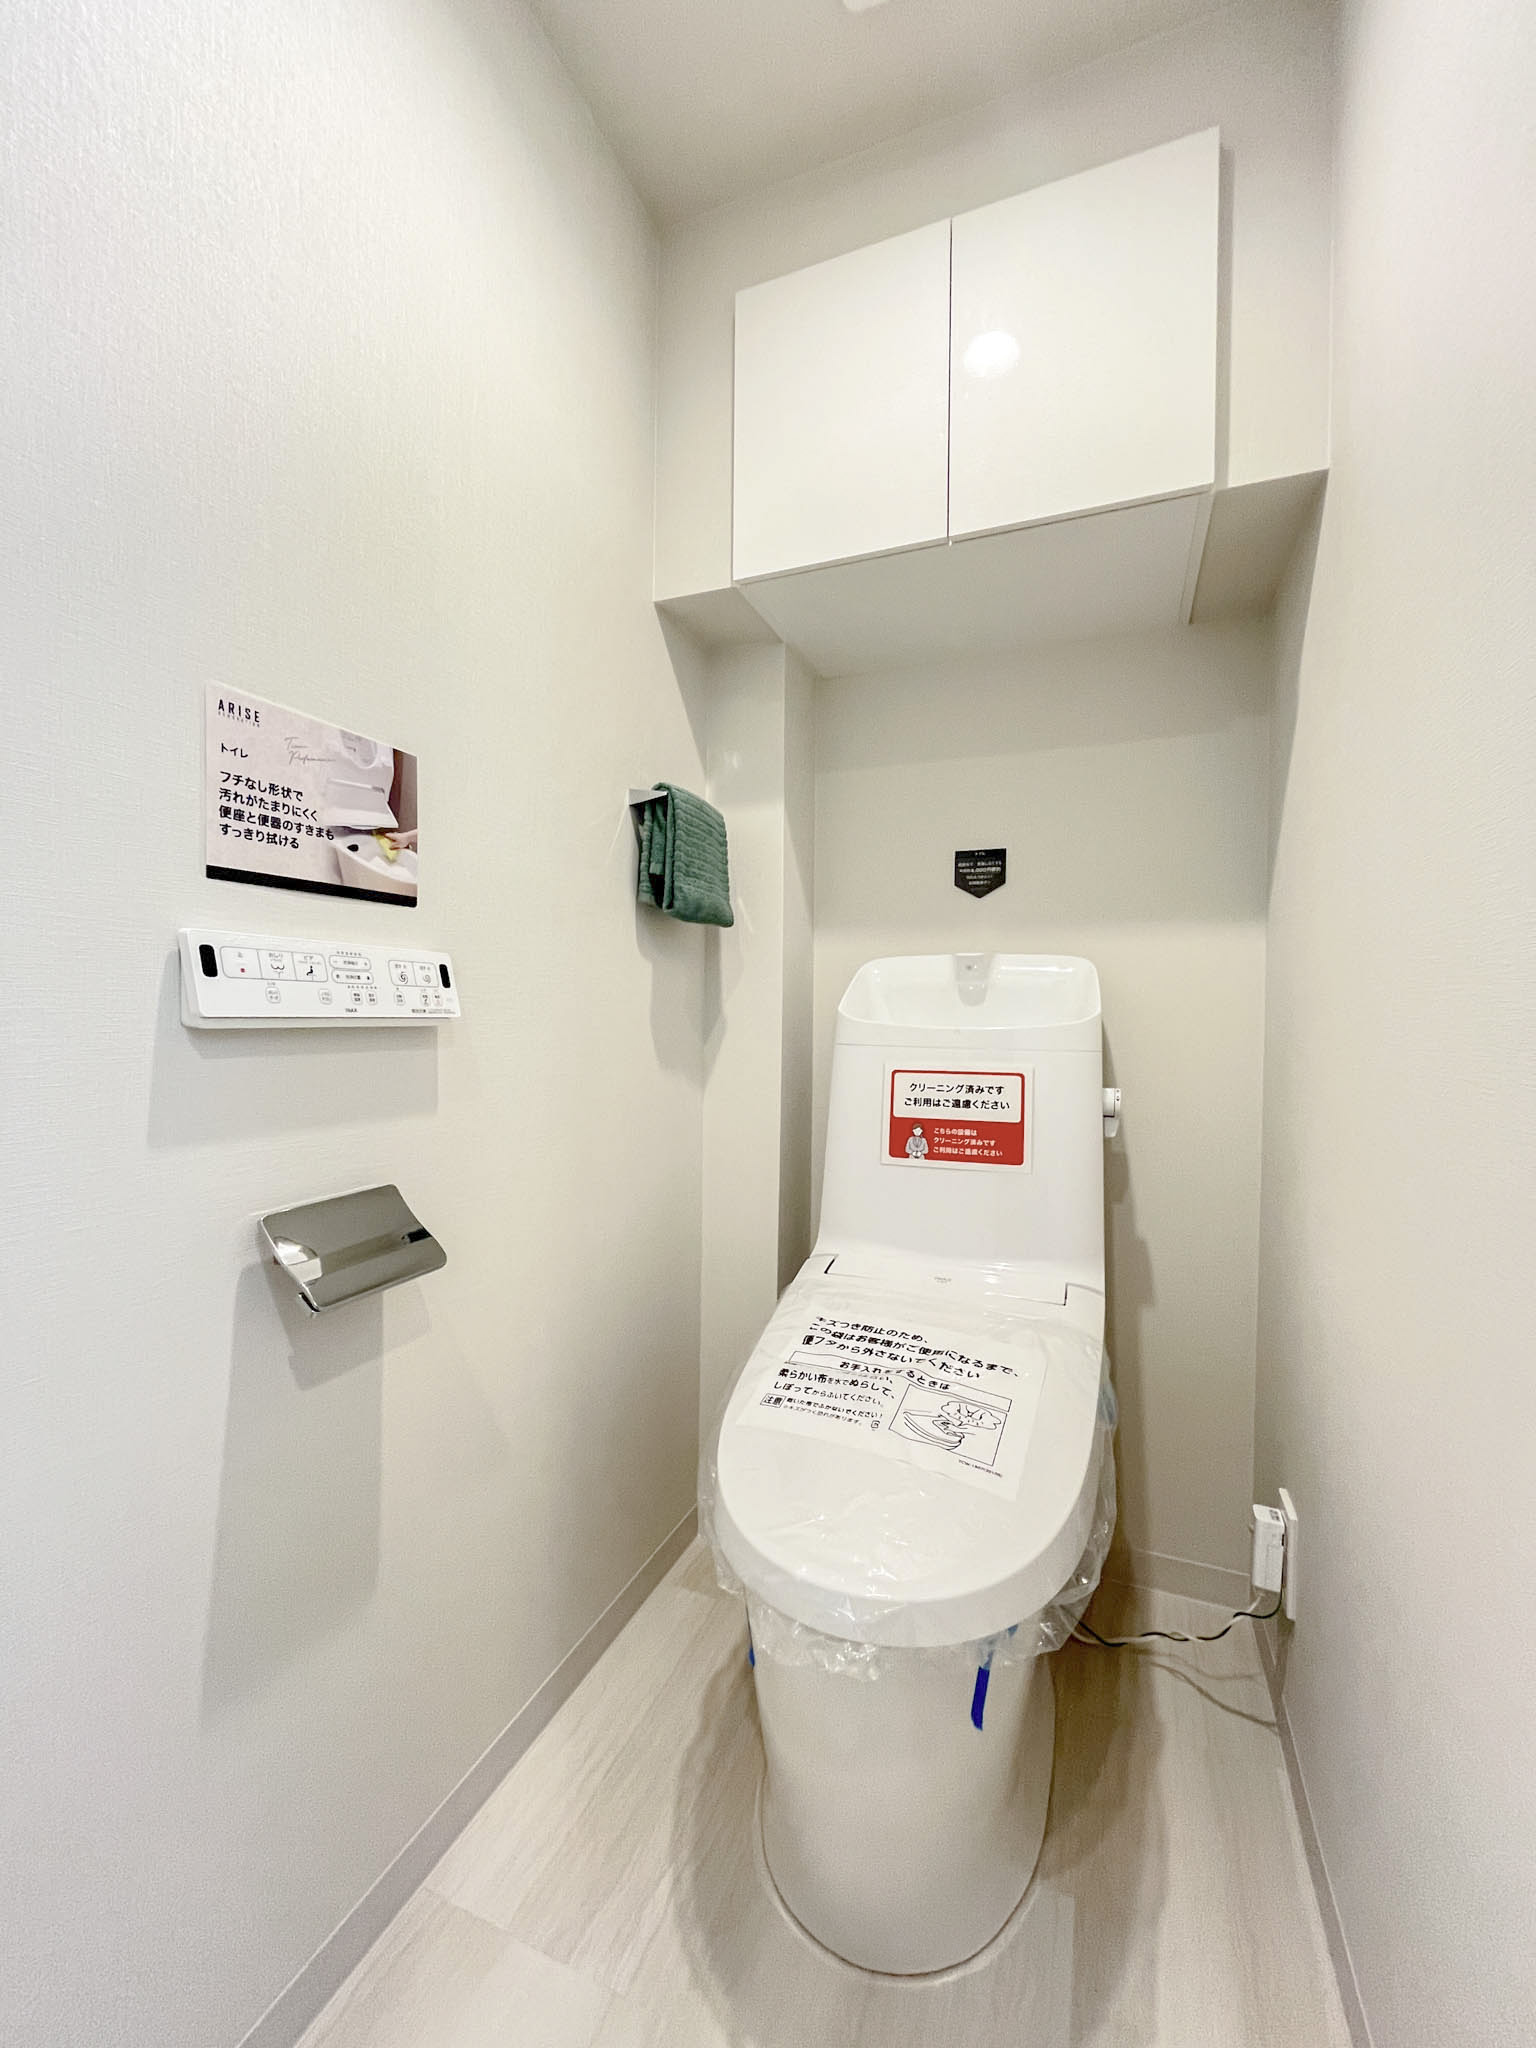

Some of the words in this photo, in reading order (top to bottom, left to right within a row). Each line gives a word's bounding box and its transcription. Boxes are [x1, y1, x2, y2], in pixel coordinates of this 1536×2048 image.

[218, 699, 260, 723] ARISE
[221, 743, 249, 758] トイレ
[219, 770, 304, 802] フチなし形状で
[218, 787, 318, 822] 汚れがたまりにくく
[218, 805, 335, 841] 便座と便器のすきまも
[219, 823, 300, 849] すっきり拭ける
[909, 1082, 1005, 1096] クリーニング済みです
[904, 1097, 1010, 1111] ご利用はご遠慮ください
[933, 1137, 996, 1147] クリーニング済みです
